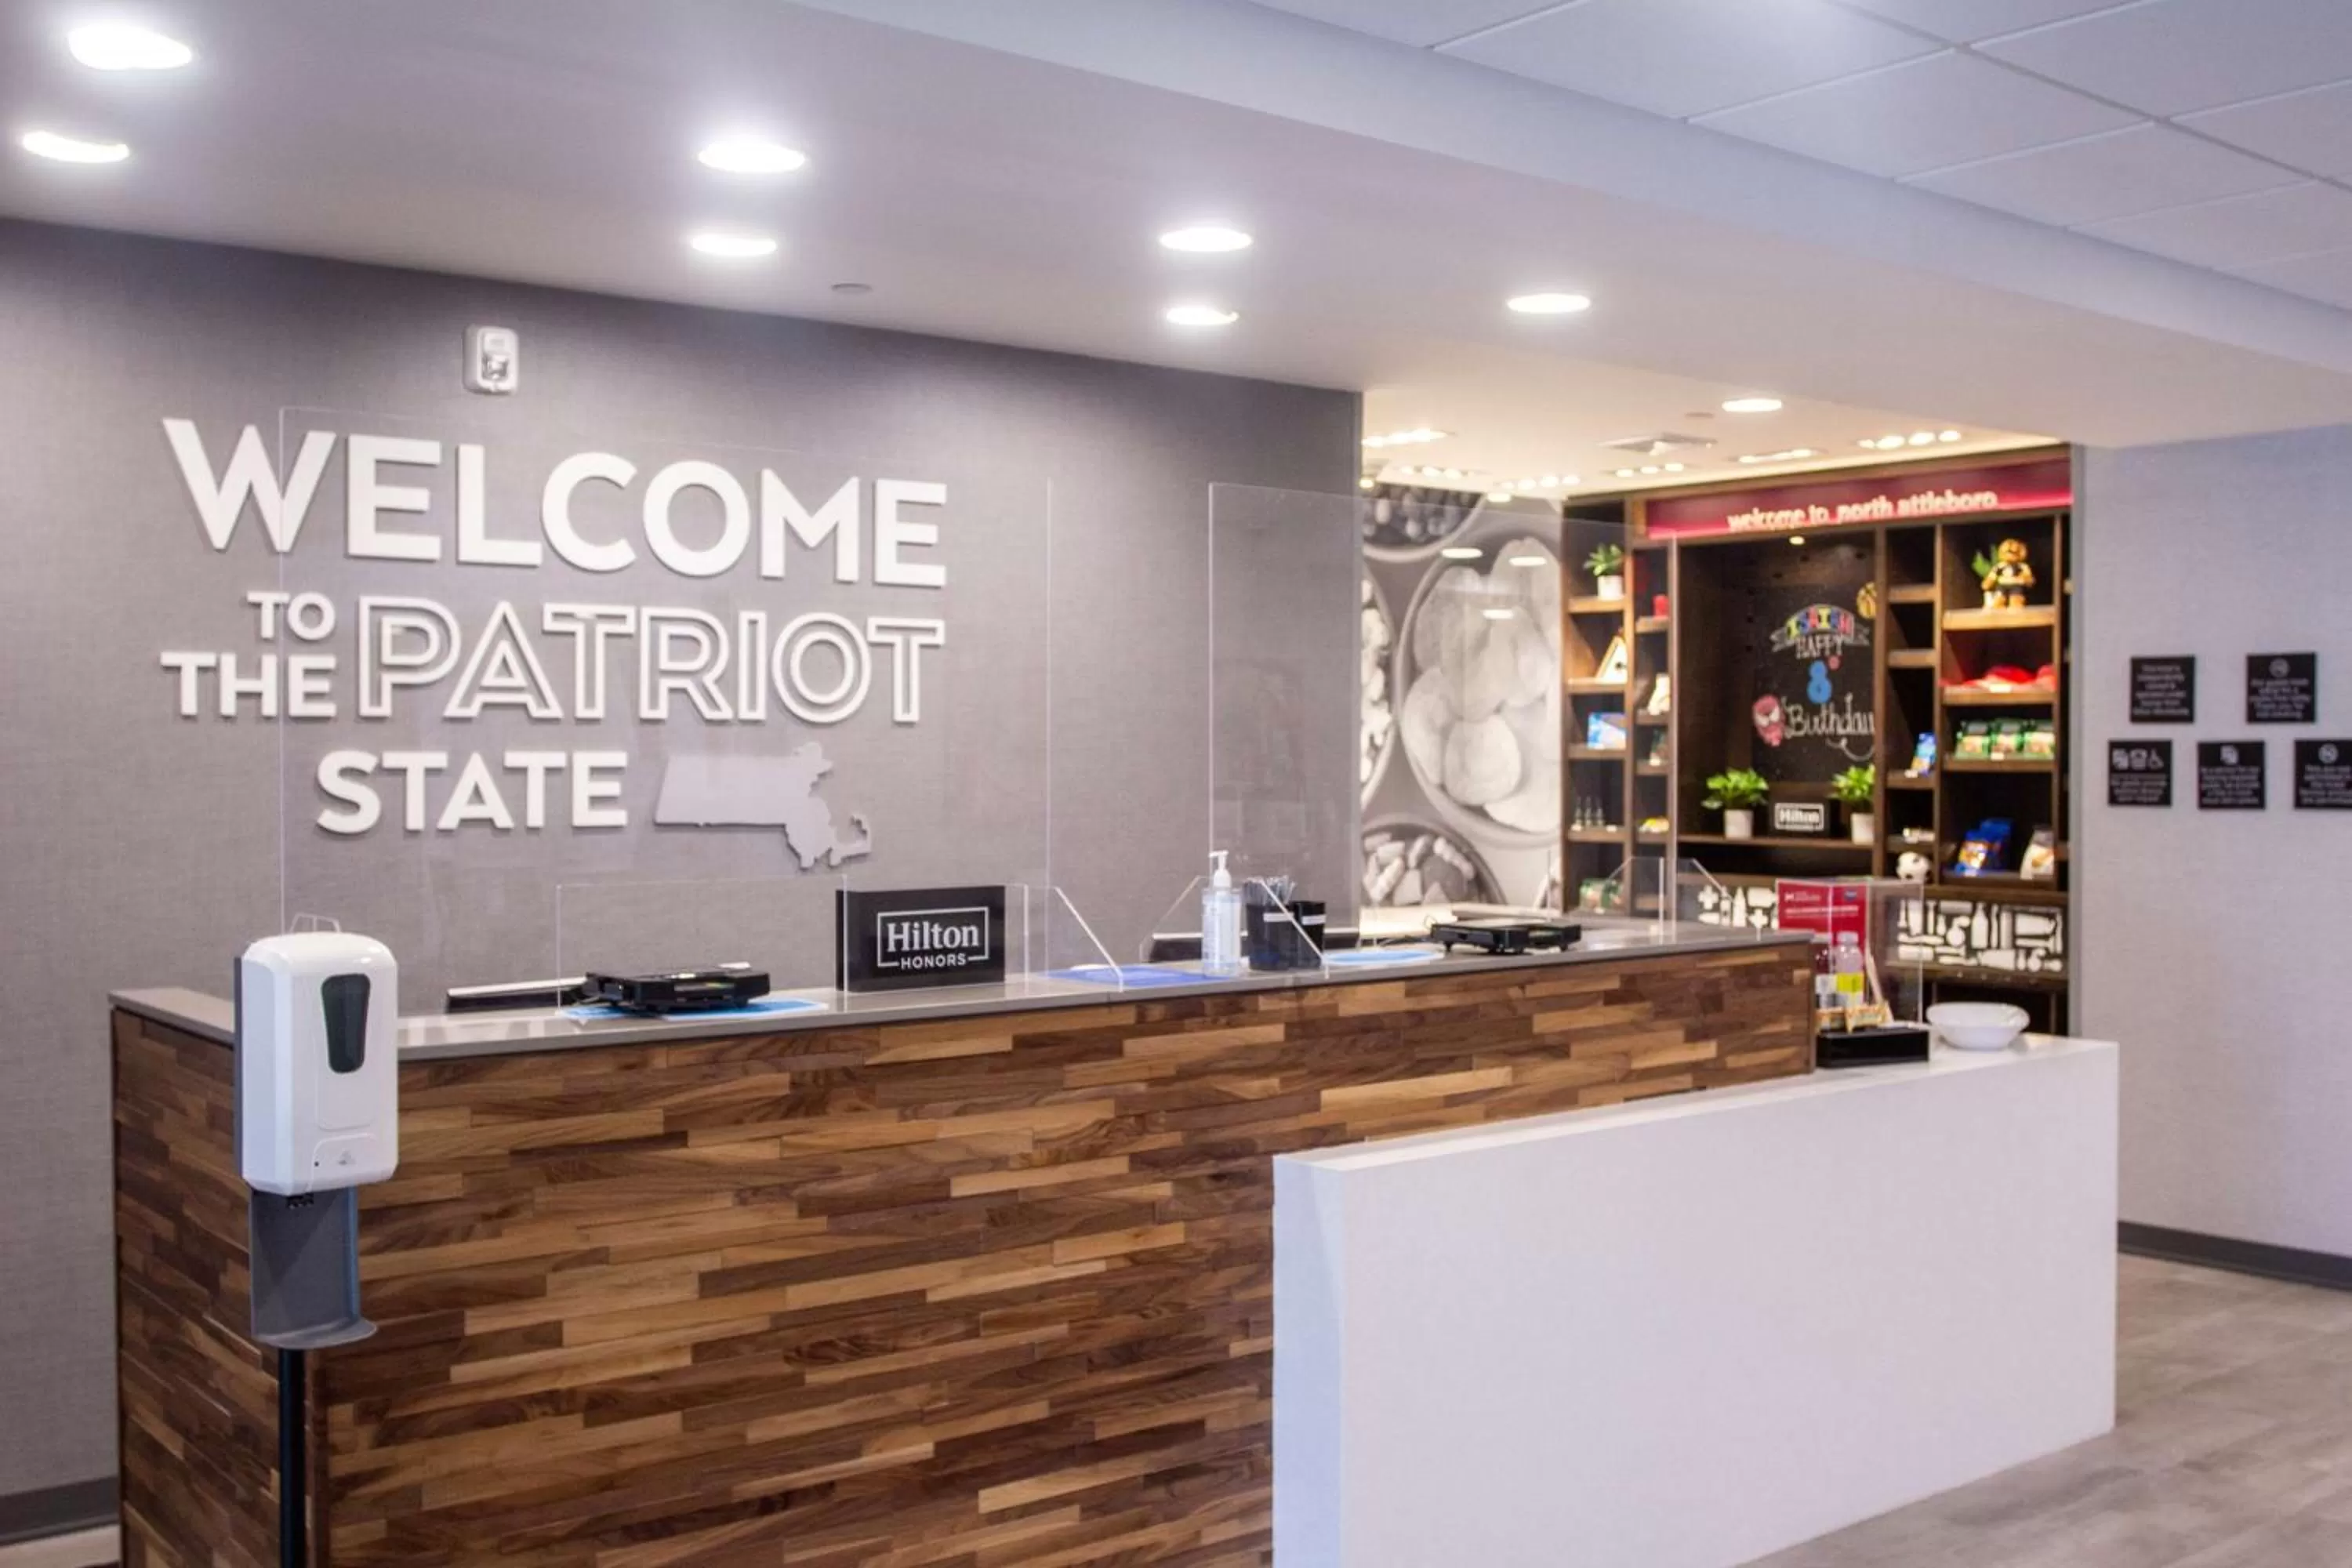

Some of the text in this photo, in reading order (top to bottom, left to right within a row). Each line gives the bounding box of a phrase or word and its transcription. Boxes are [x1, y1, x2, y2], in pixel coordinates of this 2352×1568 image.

[163, 419, 948, 586] WELCOME
[1727, 489, 1998, 533] welcome to north attleboro
[247, 591, 336, 639] TO
[161, 594, 947, 724] THE PATRIOT
[1795, 634, 1843, 659] HAPPY
[1806, 659, 1832, 704] 8
[318, 750, 628, 832] STATE
[887, 920, 979, 953] Hilton
[901, 953, 967, 970] HONORS
